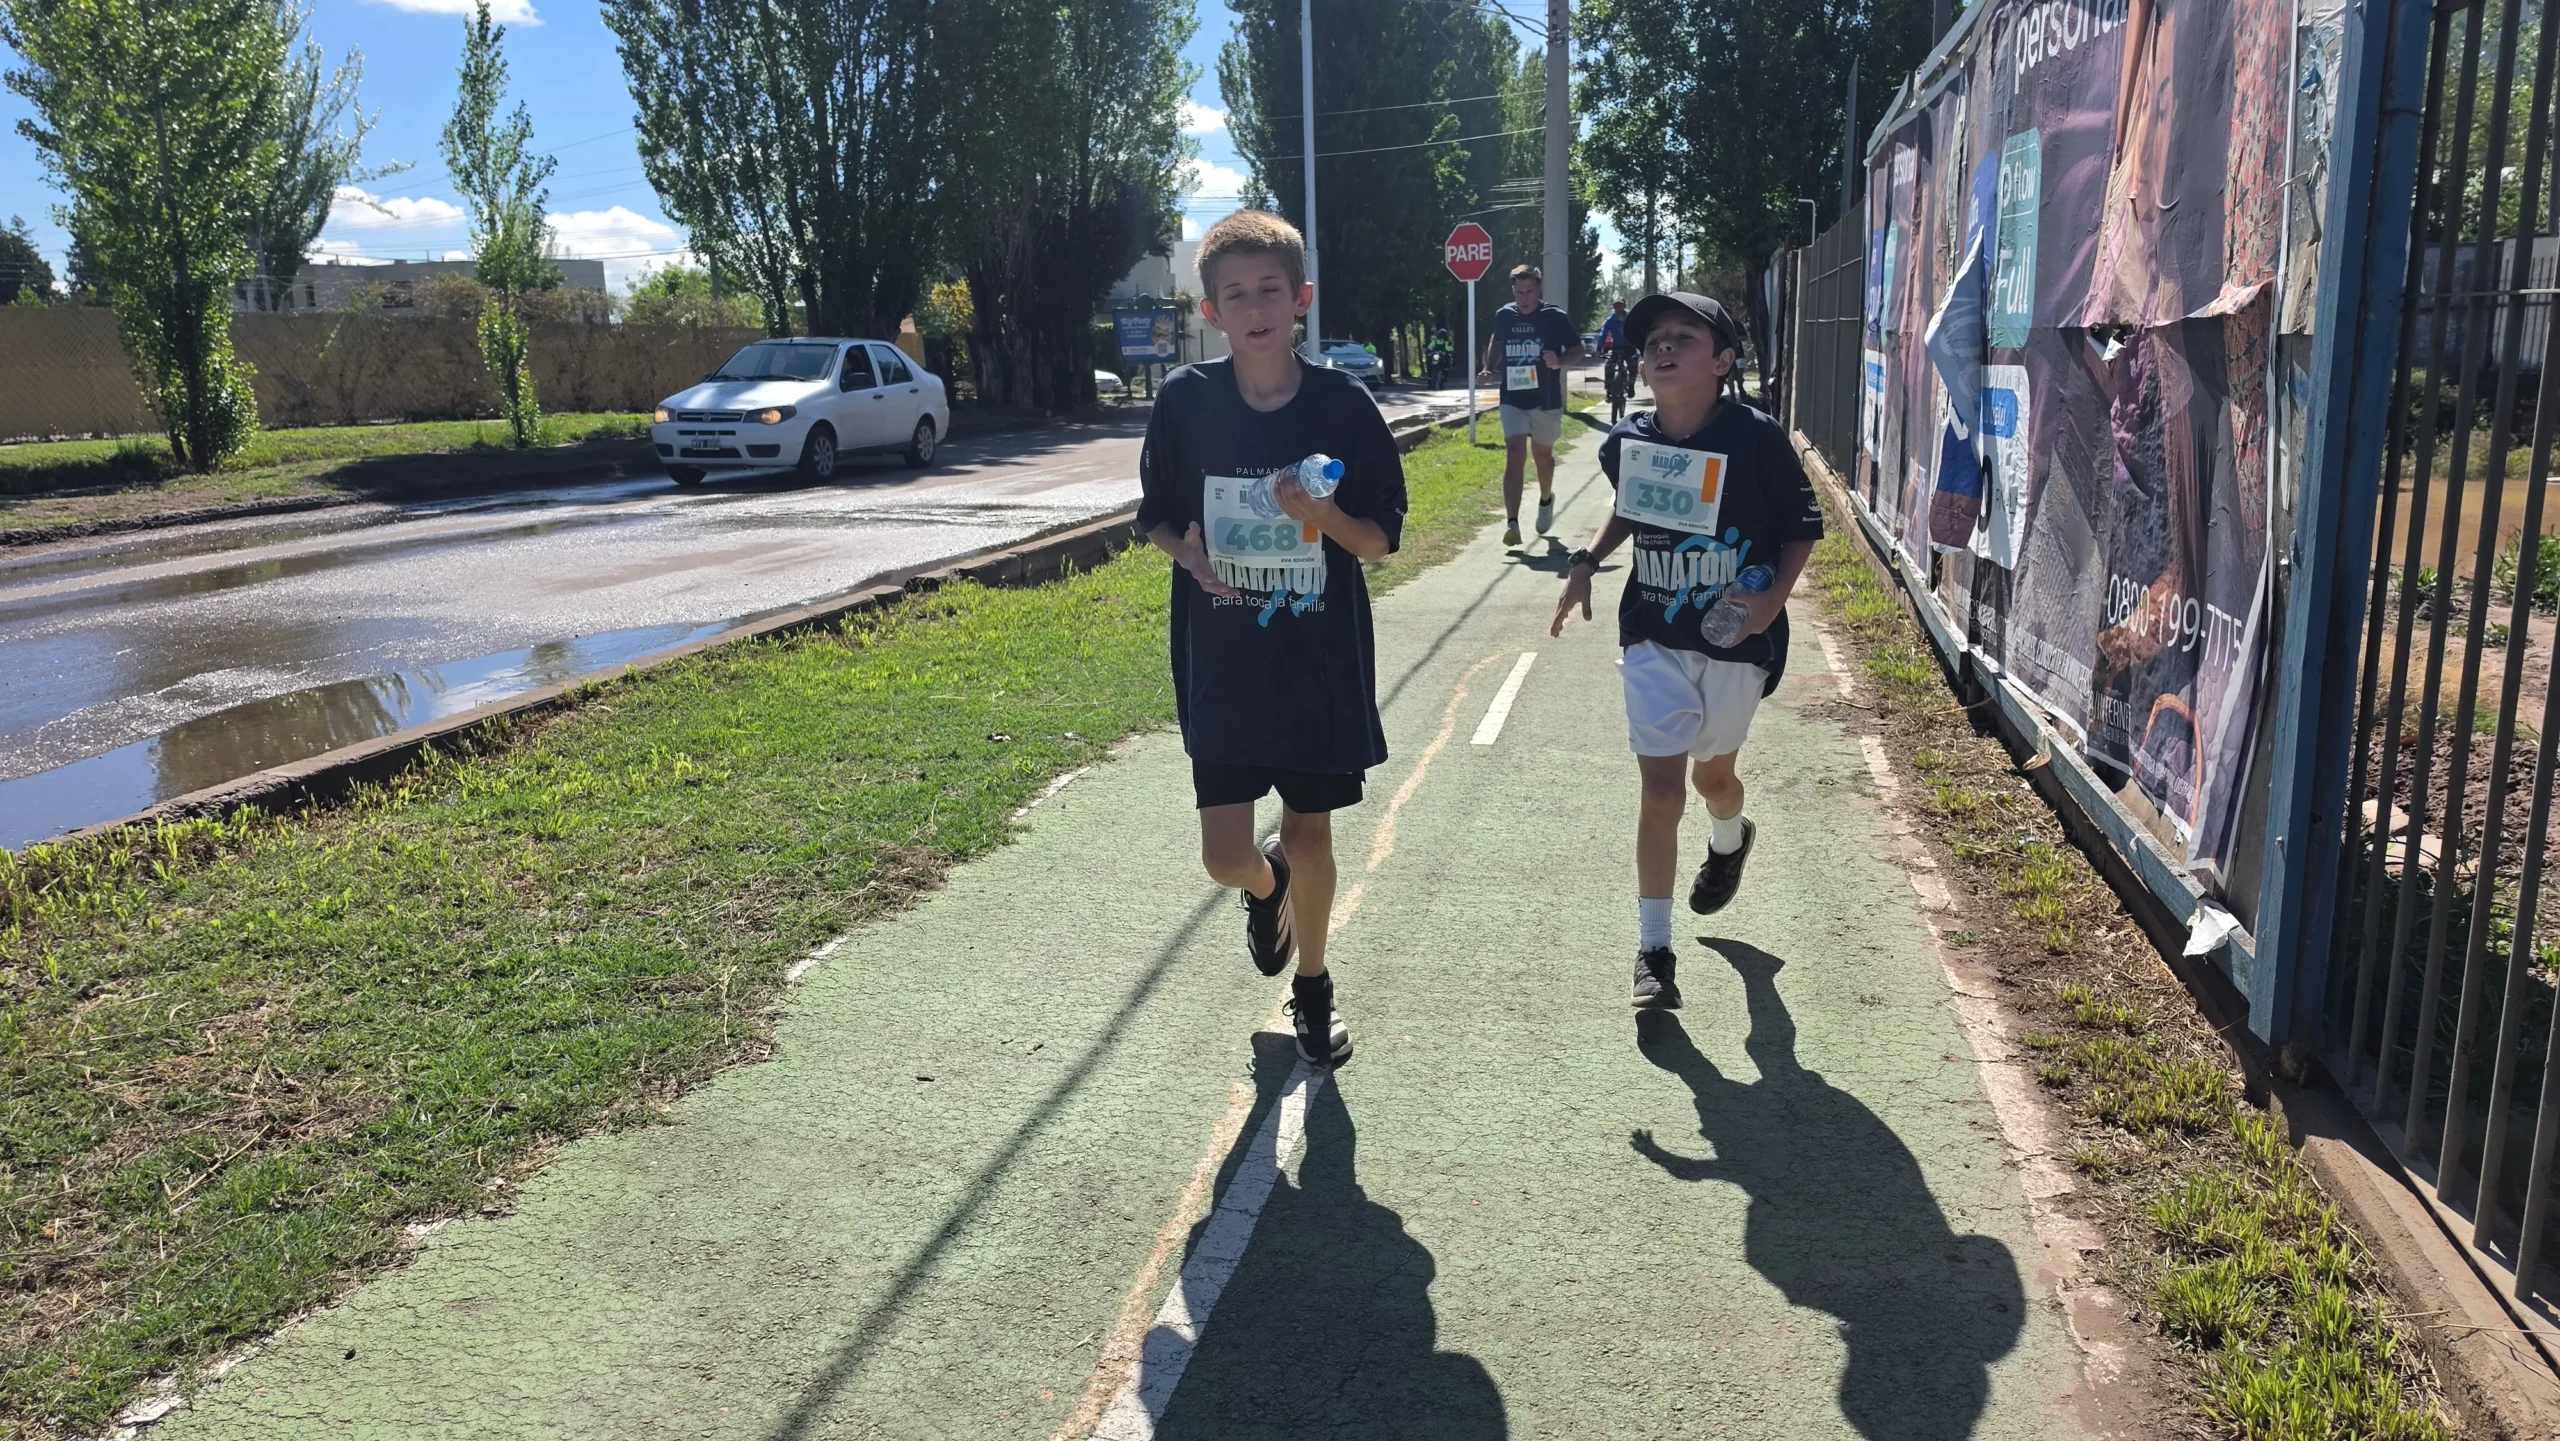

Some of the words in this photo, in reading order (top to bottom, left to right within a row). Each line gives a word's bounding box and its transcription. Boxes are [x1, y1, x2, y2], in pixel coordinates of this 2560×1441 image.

[2014, 160, 2036, 201] flow
[1447, 242, 1491, 262] PARE
[1994, 246, 2031, 315] Full
[1636, 482, 1694, 516] 330
[1226, 524, 1298, 552] 468
[1212, 595, 1243, 609] para
[1245, 595, 1272, 610] toda
[1274, 595, 1286, 608] la
[1288, 595, 1325, 612] familia
[1642, 590, 1656, 602] ara
[1679, 592, 1689, 605] la
[1691, 586, 1725, 603] famil
[2107, 573, 2242, 672] 0800-199-7775
